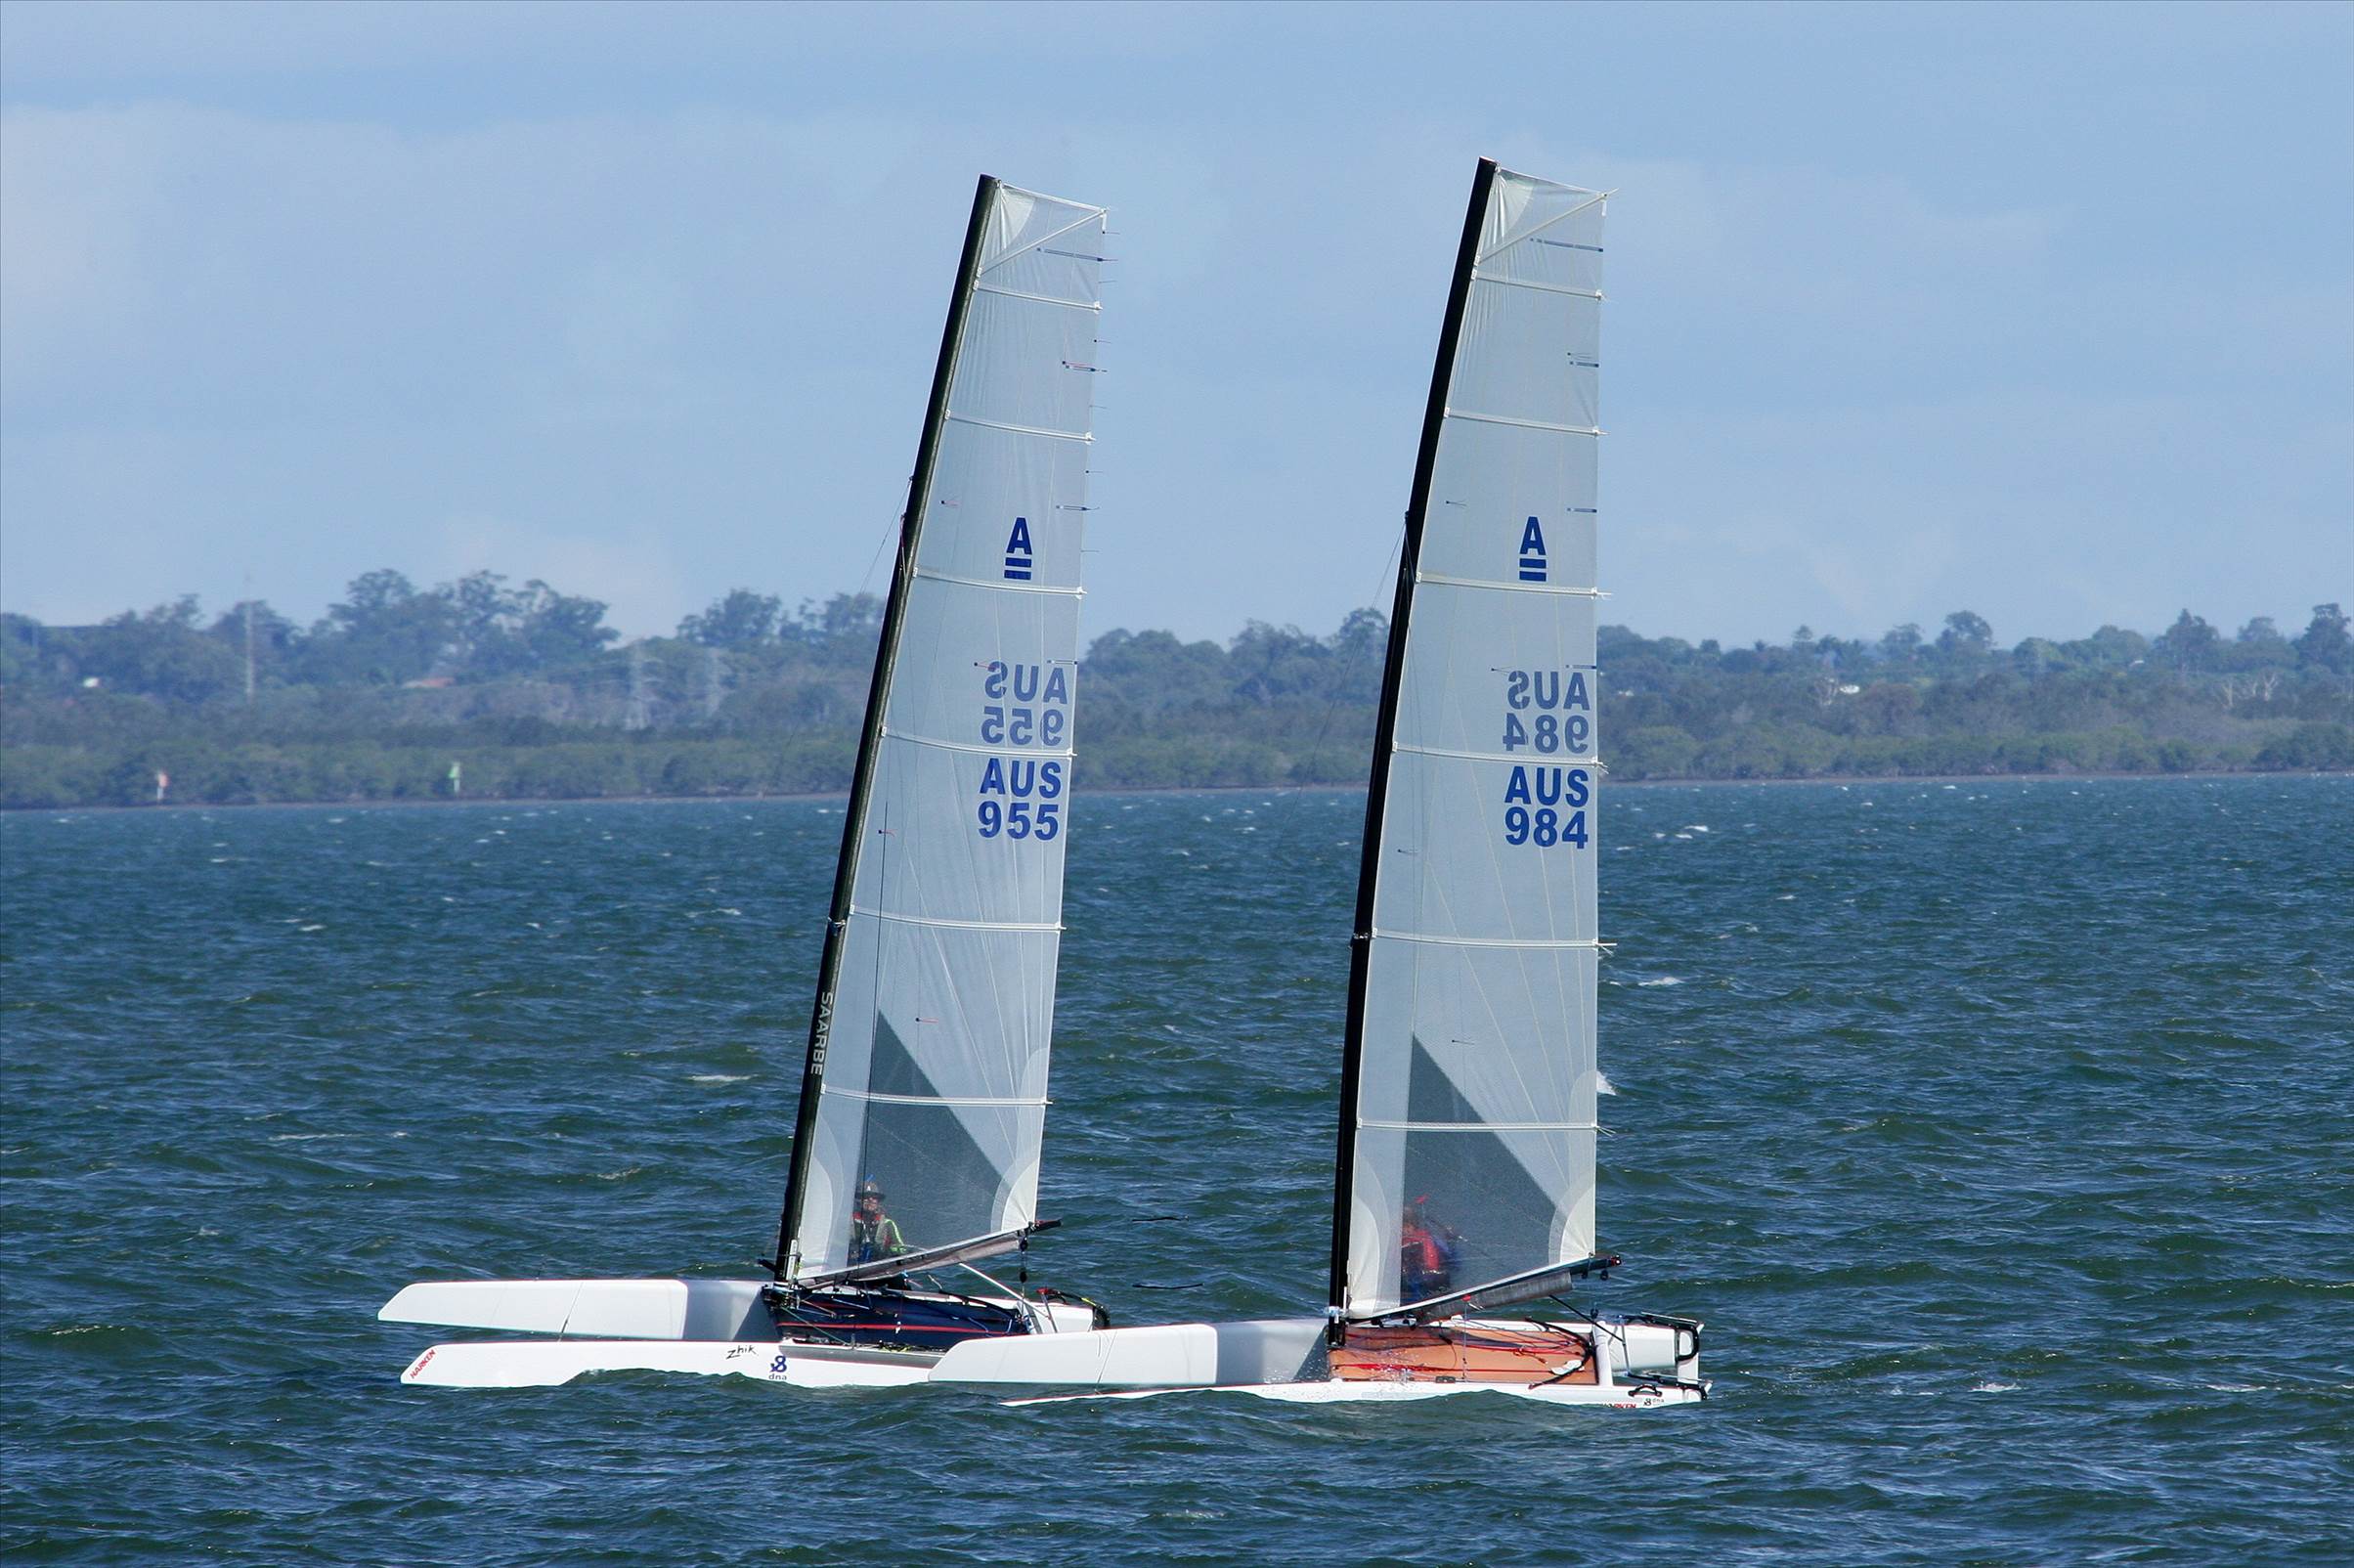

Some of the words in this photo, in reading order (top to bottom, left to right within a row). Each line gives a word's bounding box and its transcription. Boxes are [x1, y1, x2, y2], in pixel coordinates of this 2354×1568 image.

[1006, 517, 1032, 555] A
[1519, 516, 1547, 555] A
[980, 758, 1062, 800] AUS
[1504, 765, 1589, 808] AUS
[978, 801, 1059, 841] 955
[1504, 806, 1589, 849] 984
[810, 991, 834, 1075] SAARBE
[410, 1349, 436, 1379] HARKEN
